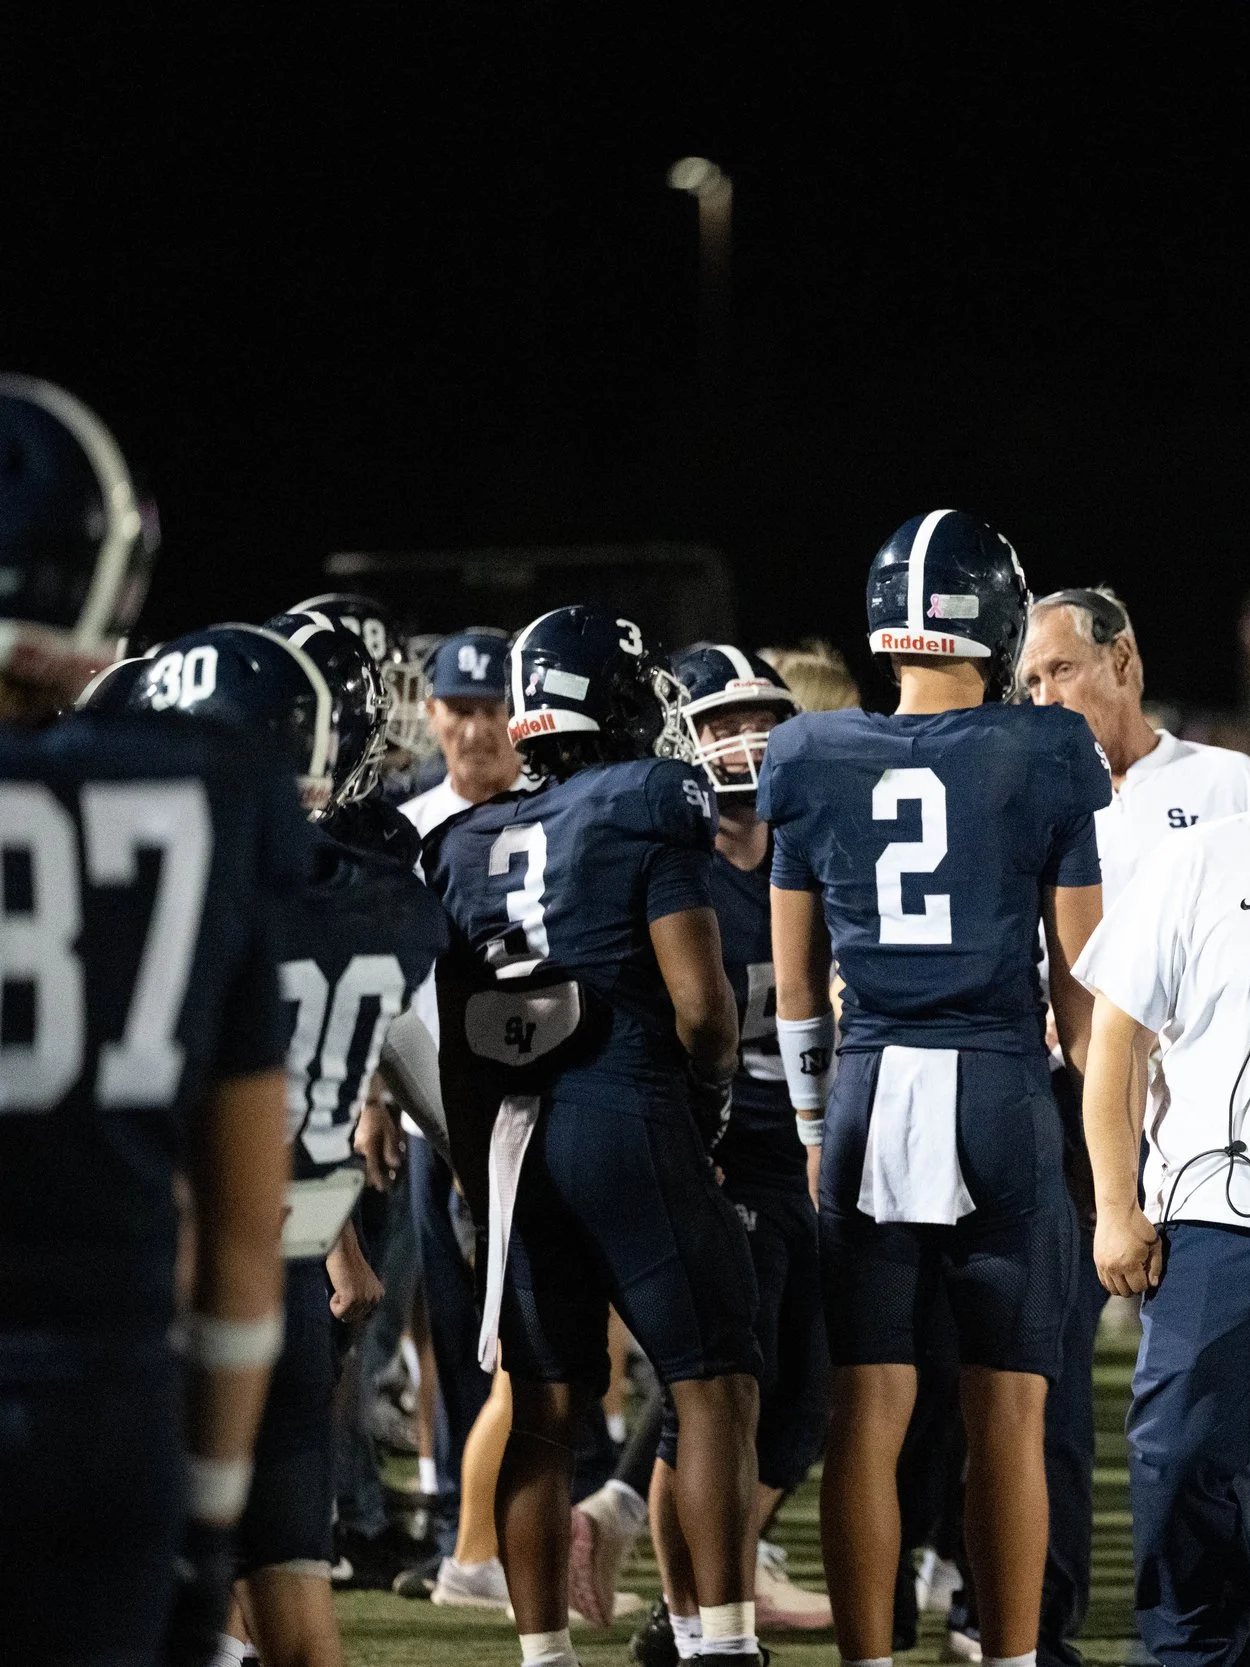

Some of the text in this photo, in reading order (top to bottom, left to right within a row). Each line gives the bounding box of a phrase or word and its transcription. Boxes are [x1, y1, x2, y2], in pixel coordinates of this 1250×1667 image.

[615, 618, 643, 656] 3
[881, 633, 955, 654] Riddell
[149, 645, 219, 712] 30
[872, 767, 952, 945] 2
[485, 821, 550, 980] 3
[0, 779, 212, 1111] 87
[504, 1015, 537, 1054] SV
